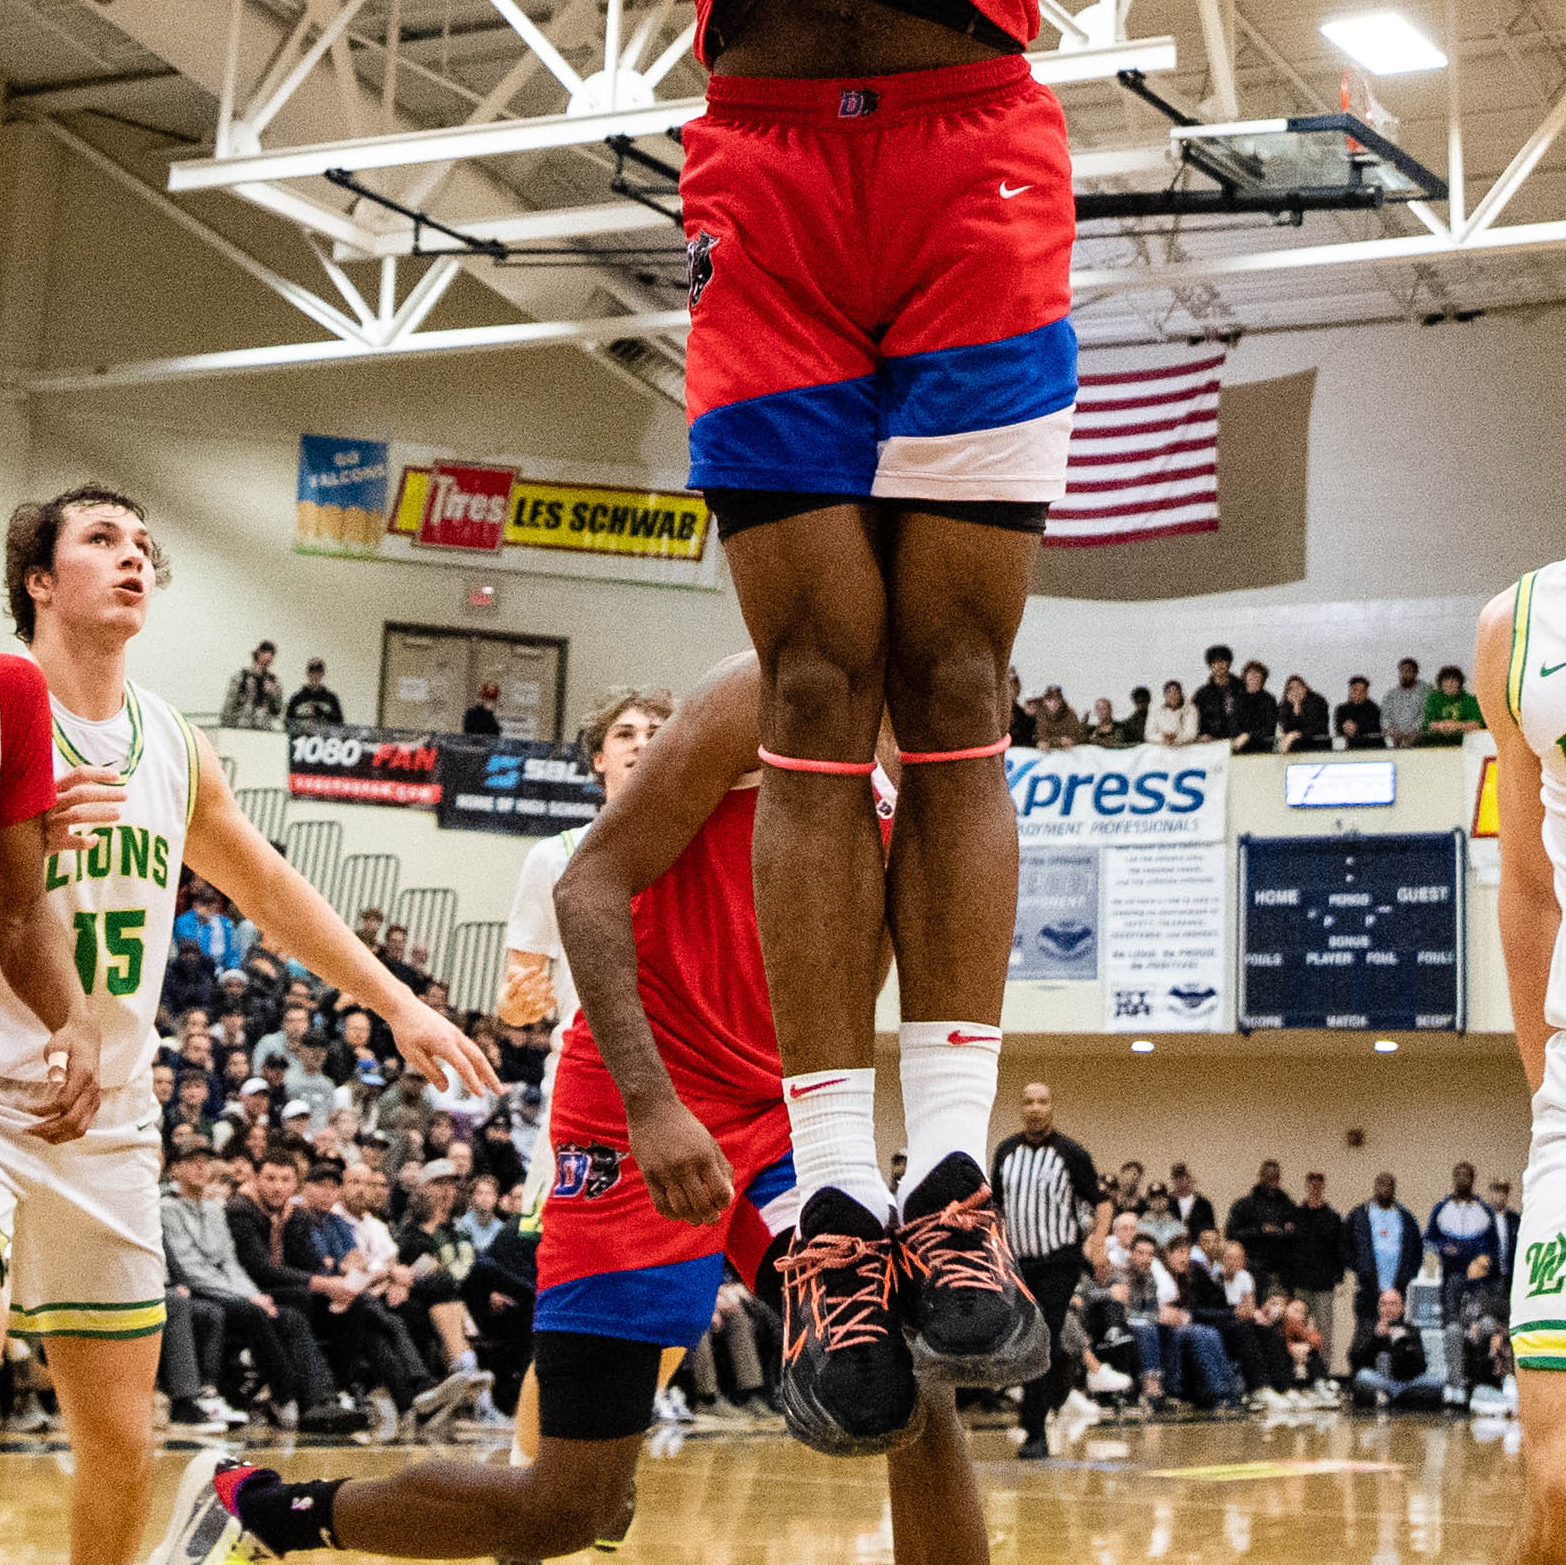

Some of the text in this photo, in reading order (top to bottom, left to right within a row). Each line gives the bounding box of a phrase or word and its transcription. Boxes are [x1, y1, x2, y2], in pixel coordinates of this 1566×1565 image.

[430, 472, 505, 525] Tires
[514, 496, 698, 541] LES SCHWAB
[292, 735, 363, 767] 1080
[1254, 889, 1300, 906] HOME
[1397, 885, 1450, 903] GUEST
[1306, 952, 1354, 965] PLAYER
[1366, 952, 1399, 965] FOUL
